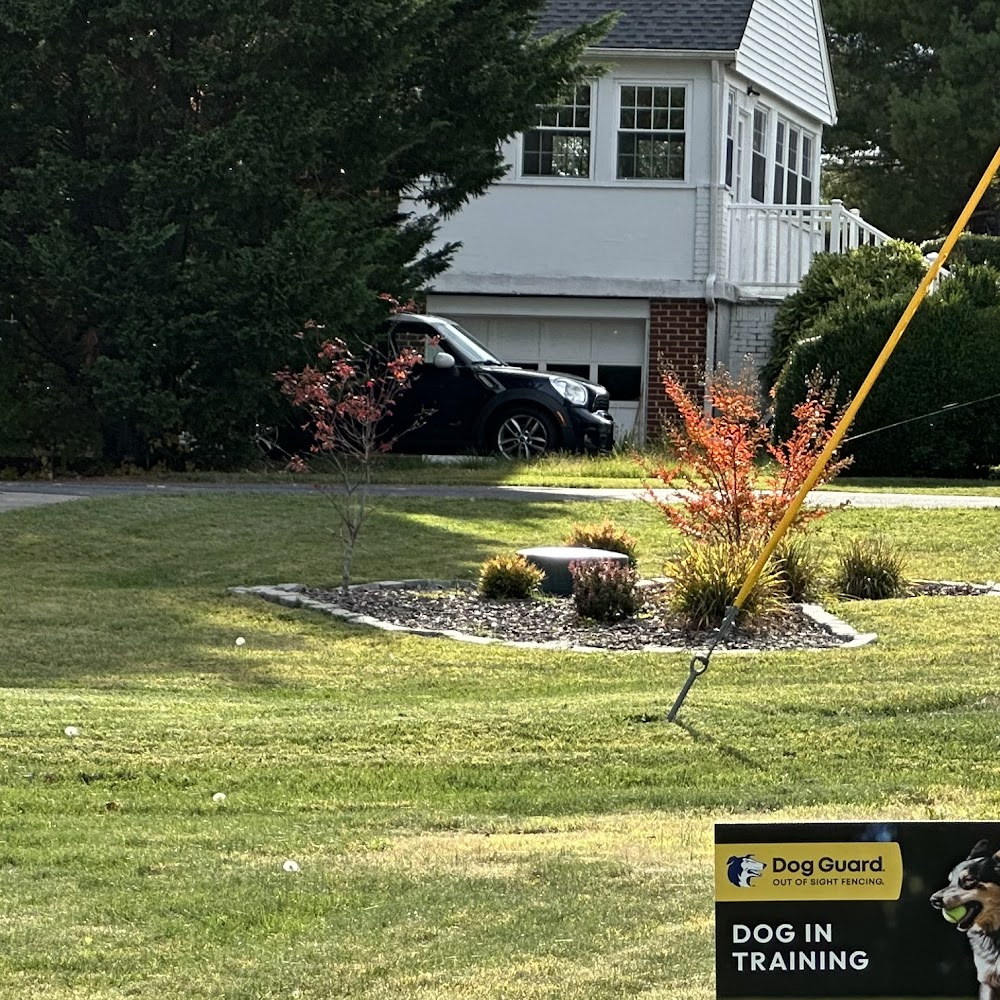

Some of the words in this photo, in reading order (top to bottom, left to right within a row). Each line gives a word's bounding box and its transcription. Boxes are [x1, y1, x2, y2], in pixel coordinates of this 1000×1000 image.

[772, 857, 814, 876] Dog
[818, 856, 883, 873] Guard
[772, 878, 792, 887] OUT
[795, 878, 808, 886] OF
[810, 878, 838, 886] SIGHT
[732, 923, 796, 944] DOG
[805, 923, 832, 943] IN
[732, 950, 869, 972] TRAINING
